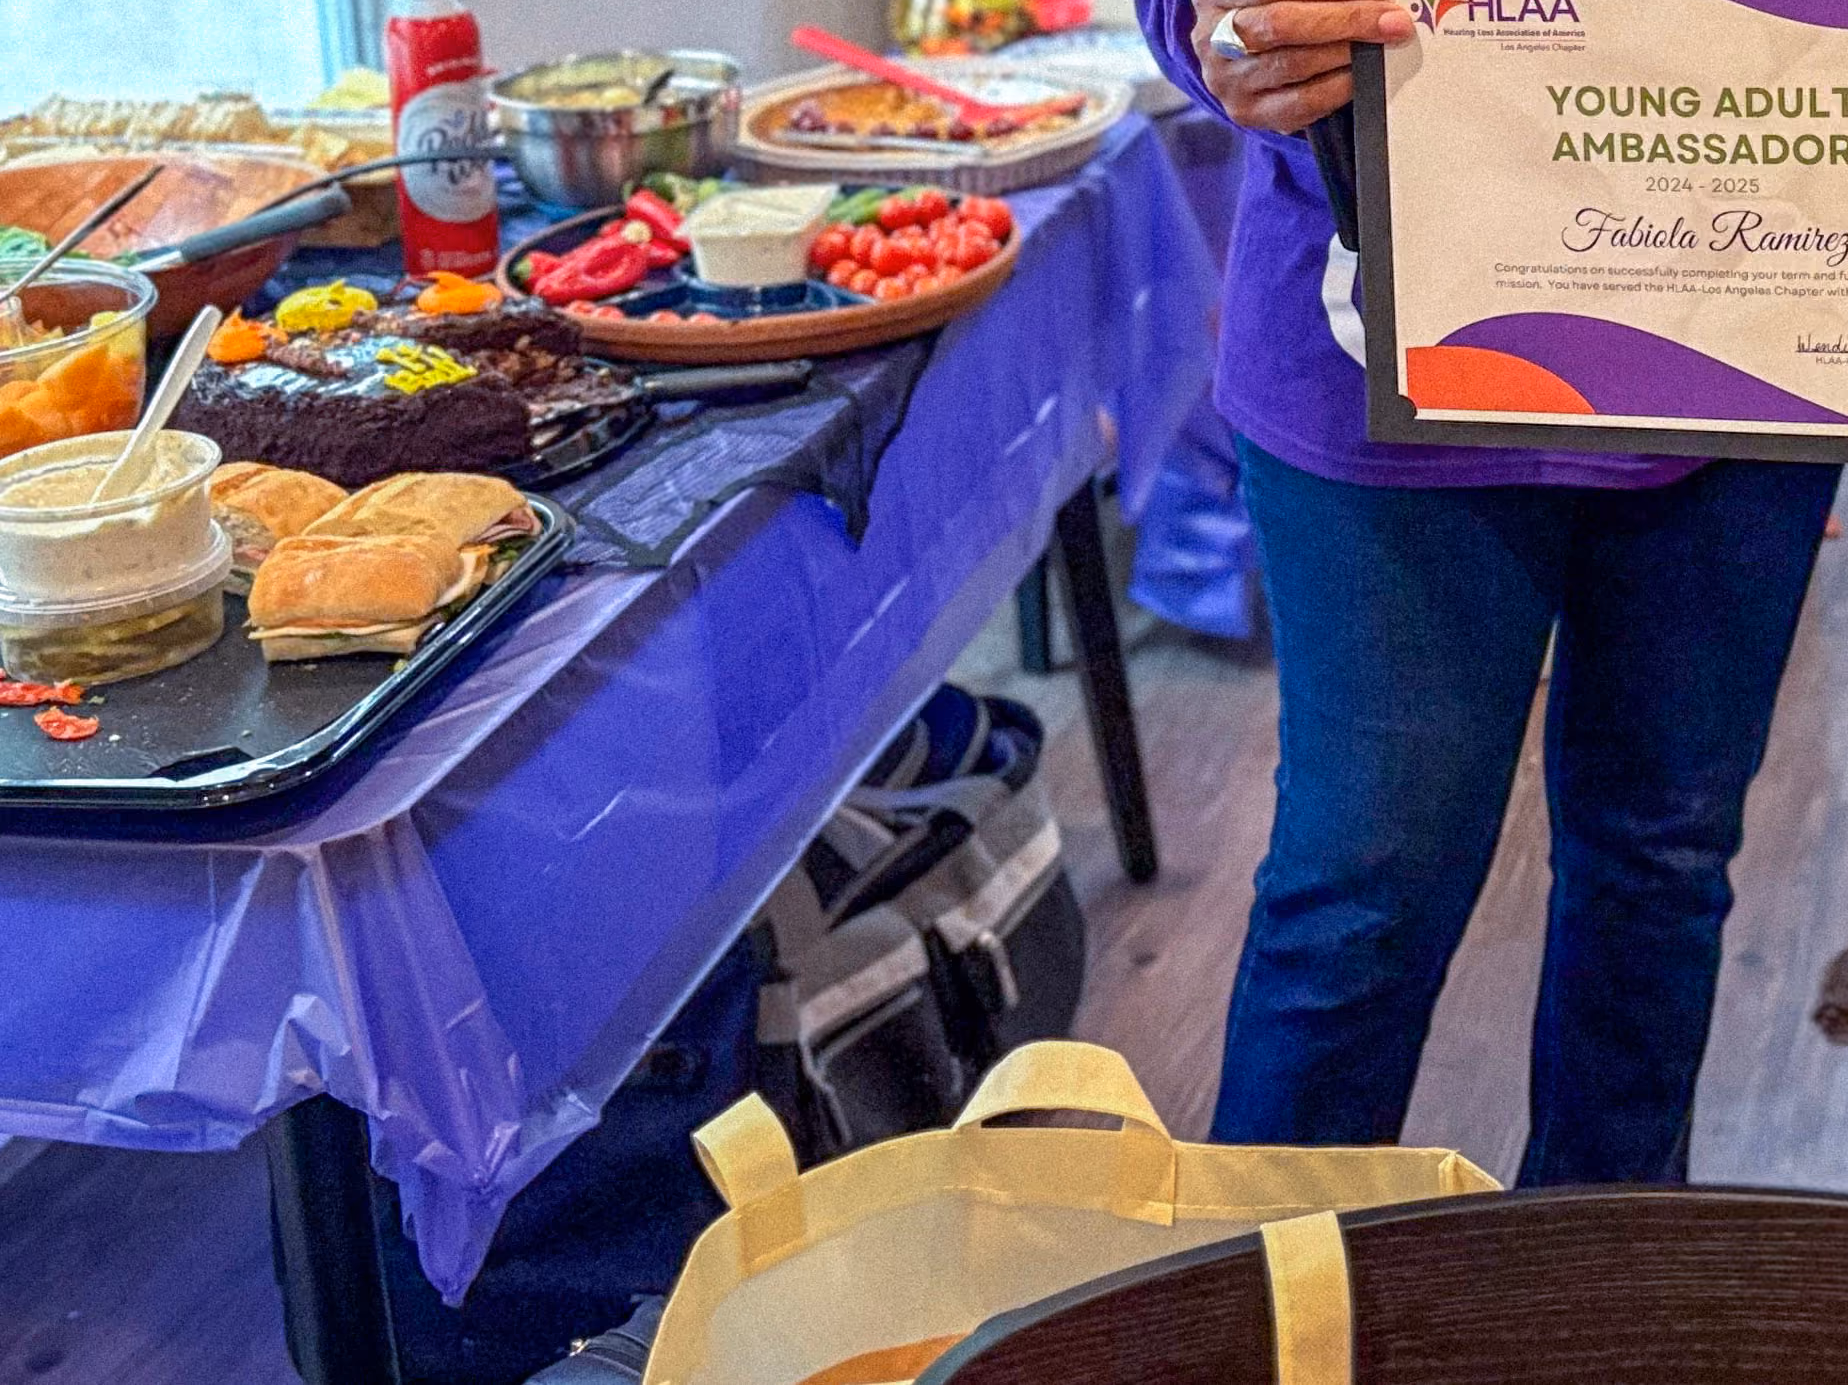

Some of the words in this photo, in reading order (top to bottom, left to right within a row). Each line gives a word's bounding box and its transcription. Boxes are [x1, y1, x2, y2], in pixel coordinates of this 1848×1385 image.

[1443, 28, 1475, 38] Hearing
[1477, 28, 1494, 37] Loss
[1496, 28, 1541, 38] Association
[1542, 28, 1551, 37] of
[1552, 29, 1586, 38] America
[1501, 42, 1515, 51] Los
[1516, 43, 1550, 53] Angeles
[1552, 43, 1586, 53] Chapter
[1546, 85, 1701, 118] YOUNG
[1645, 176, 1693, 193] 2024
[1711, 178, 1760, 194] 2025
[1561, 207, 1700, 253] Fabiola
[1494, 263, 1588, 276] Congratulations
[1590, 266, 1604, 275] on
[1608, 265, 1679, 278] successfully
[1681, 267, 1749, 281] completing
[1751, 270, 1778, 282] your
[1781, 270, 1810, 281] term
[1813, 270, 1836, 281] and
[1495, 279, 1543, 290] mission.
[1547, 280, 1570, 290] You
[1572, 281, 1600, 291] have
[1602, 281, 1642, 292] served
[1644, 282, 1664, 292] the
[1724, 284, 1772, 297] Angeles
[1774, 285, 1825, 298] Chapter
[1797, 333, 1848, 353] Wendi
